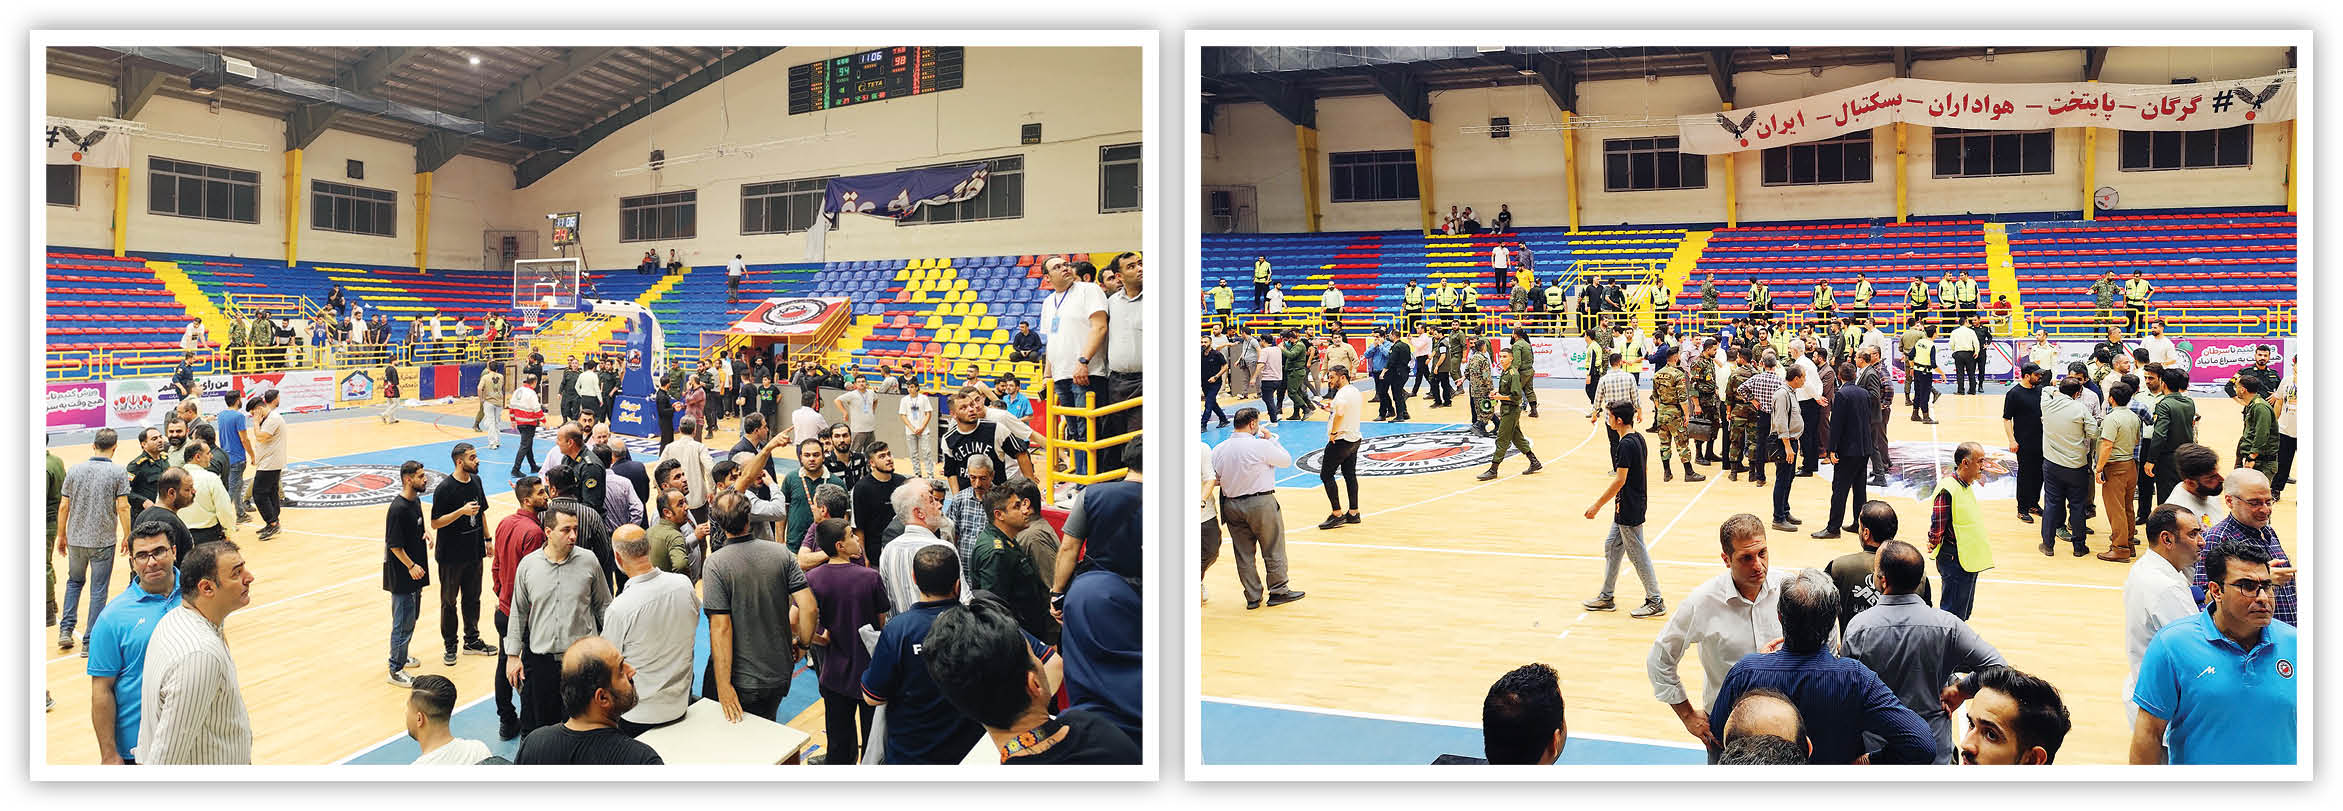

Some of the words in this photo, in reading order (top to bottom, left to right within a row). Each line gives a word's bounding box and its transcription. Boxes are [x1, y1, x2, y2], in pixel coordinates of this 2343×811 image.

[894, 56, 906, 66] 98
[839, 66, 849, 76] 94
[867, 80, 883, 89] TETA
[1835, 91, 1903, 127] بسکتبال
[1928, 92, 2015, 121] هواداران
[2048, 90, 2115, 121] پایتخت
[2141, 95, 2202, 121] گرگان
[1756, 109, 1805, 139] ایران
[2204, 347, 2229, 356] سرطان
[2219, 356, 2237, 365] سراغ
[215, 380, 228, 389] من
[58, 390, 76, 399] کنیم
[68, 399, 86, 407] وقت
[87, 398, 103, 407] هیچ
